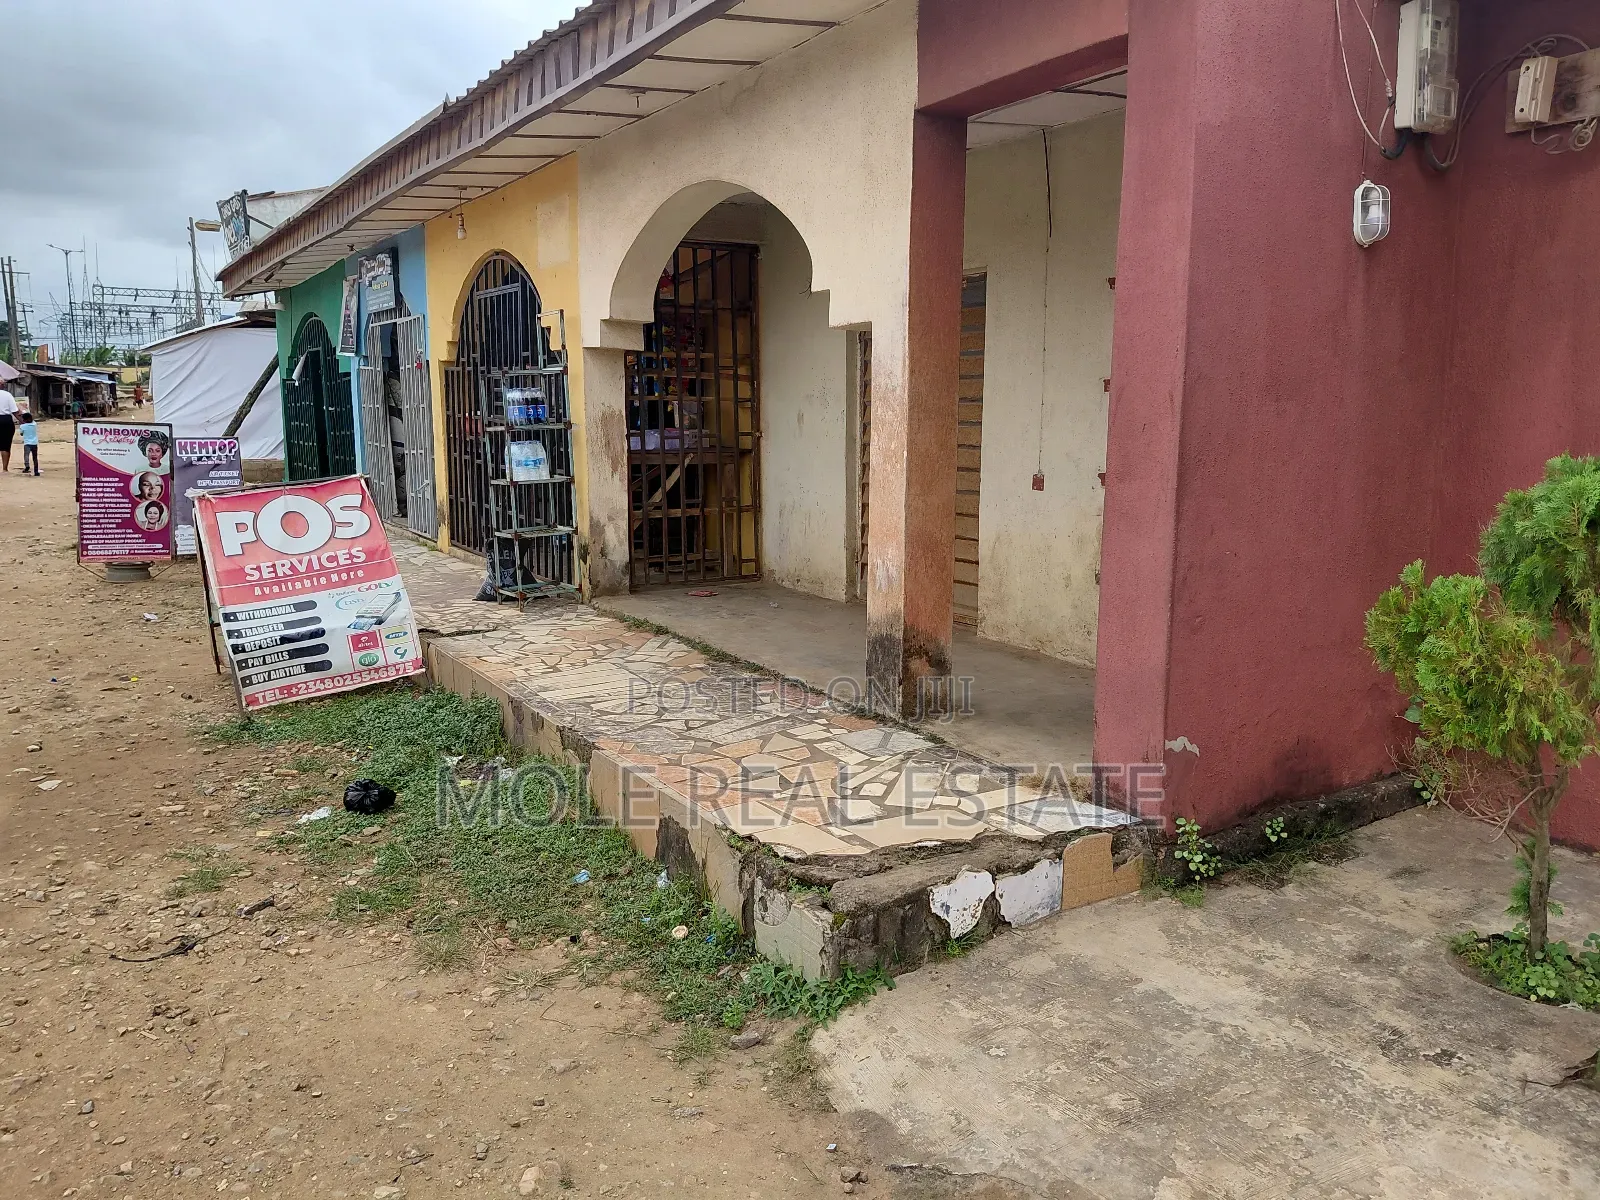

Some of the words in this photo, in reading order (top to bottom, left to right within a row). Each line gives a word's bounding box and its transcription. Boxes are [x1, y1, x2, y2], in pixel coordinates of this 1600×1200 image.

[82, 427, 151, 438] RAINBOWS
[176, 439, 238, 457] KEMTOP
[216, 494, 371, 557] POS
[244, 547, 367, 581] SERVICES
[254, 574, 327, 597] Available
[331, 569, 365, 583] Here
[236, 604, 296, 621] WITHDRAWAL
[240, 623, 284, 638] TRANSFER
[244, 636, 280, 652] DEPOSIT
[247, 657, 264, 668] PAY
[265, 651, 289, 664] BILLS
[251, 672, 272, 684] BUY
[271, 664, 307, 680] AIRTIME
[254, 688, 288, 706] TEL:
[290, 661, 414, 695] +2348025546875
